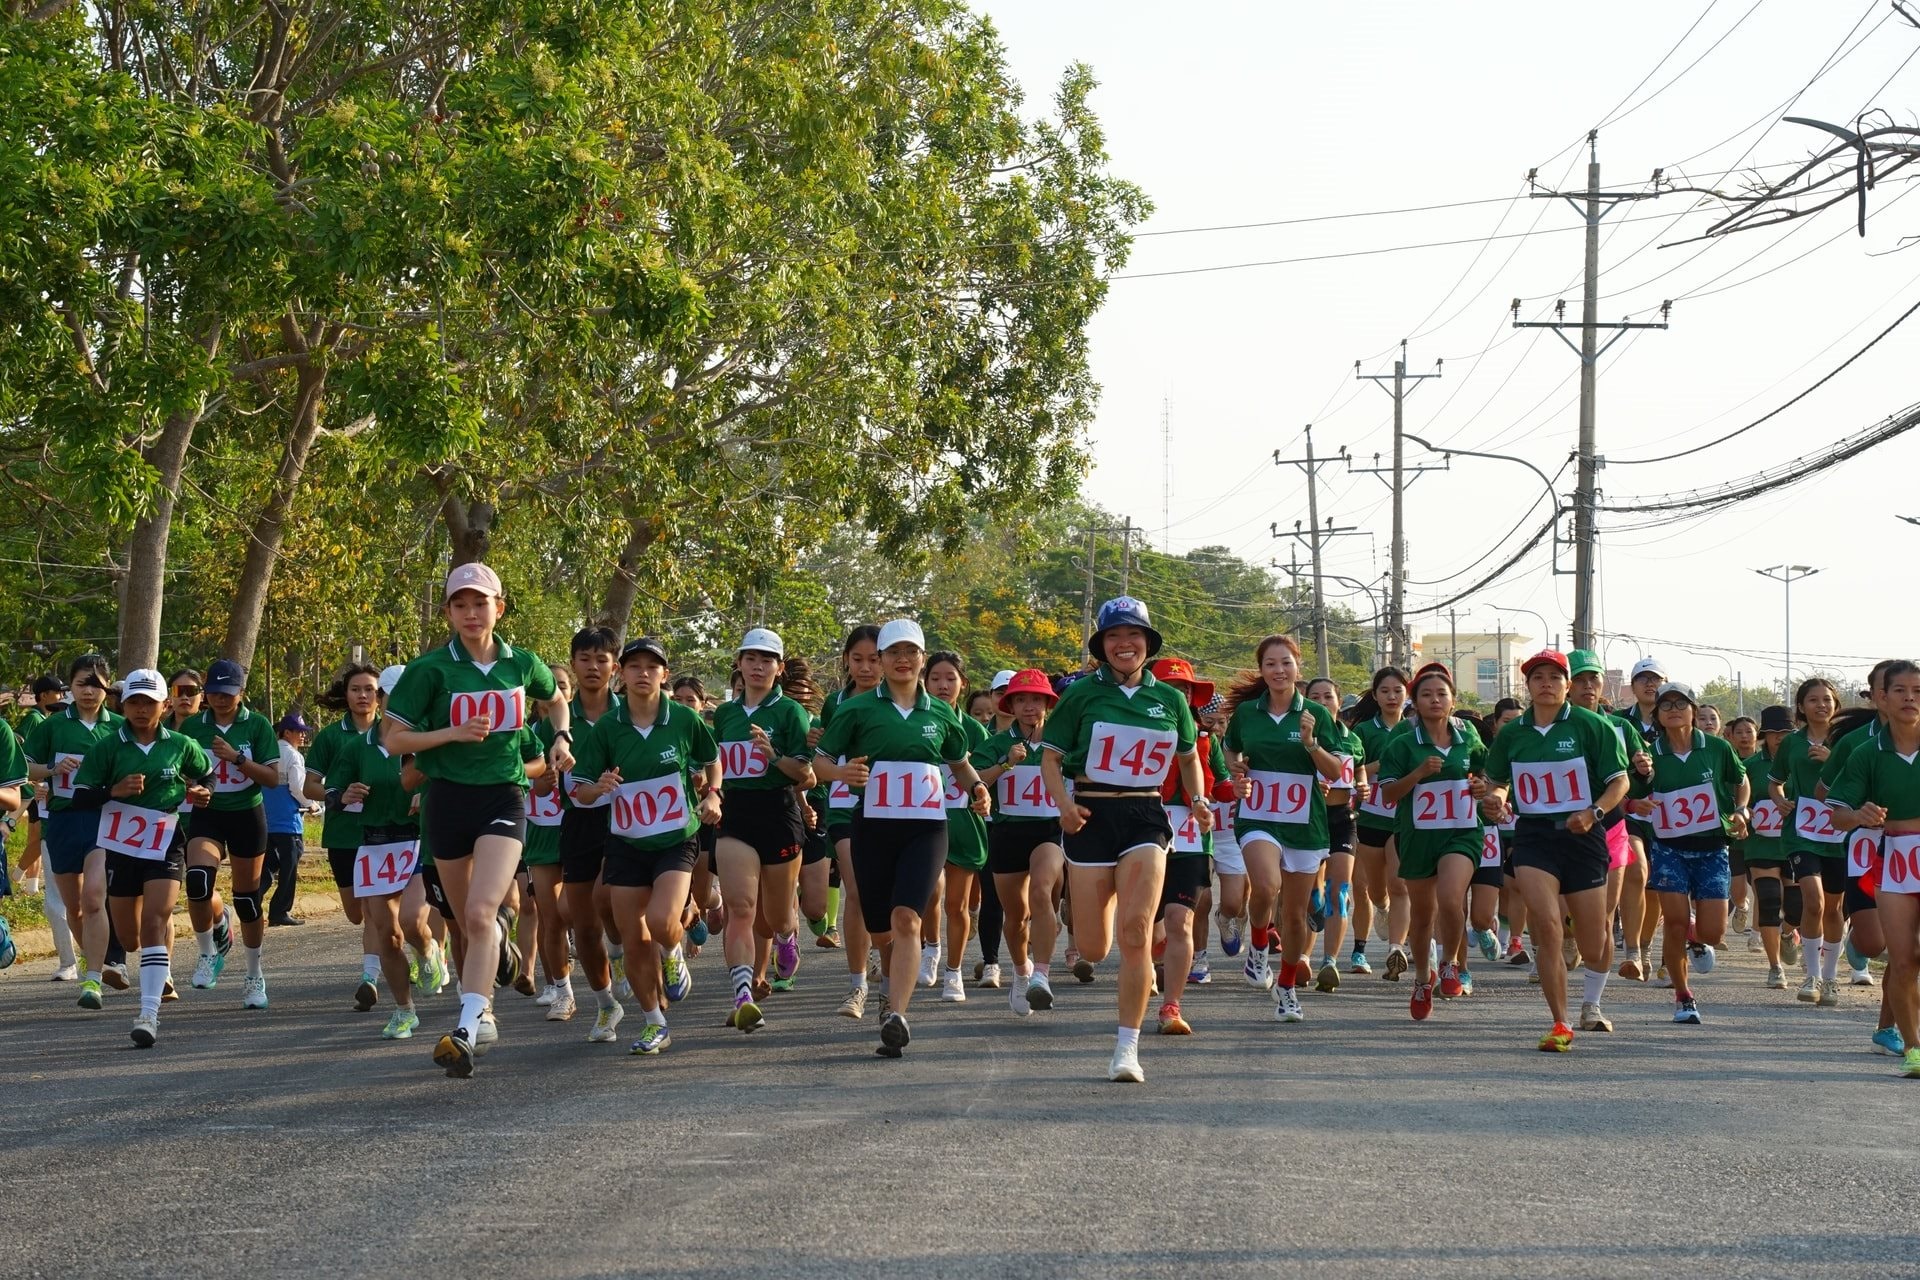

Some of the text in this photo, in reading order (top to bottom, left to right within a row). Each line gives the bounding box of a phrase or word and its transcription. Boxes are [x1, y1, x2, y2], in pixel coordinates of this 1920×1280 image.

[452, 690, 523, 730] 001
[1093, 735, 1172, 776] 145
[872, 772, 942, 809] 112
[1246, 779, 1307, 814] 019
[1417, 789, 1473, 821] 217
[1518, 769, 1585, 804] 011
[615, 785, 683, 830] 002
[1657, 793, 1715, 829] 132
[104, 811, 167, 850] 121
[357, 850, 413, 887] 142
